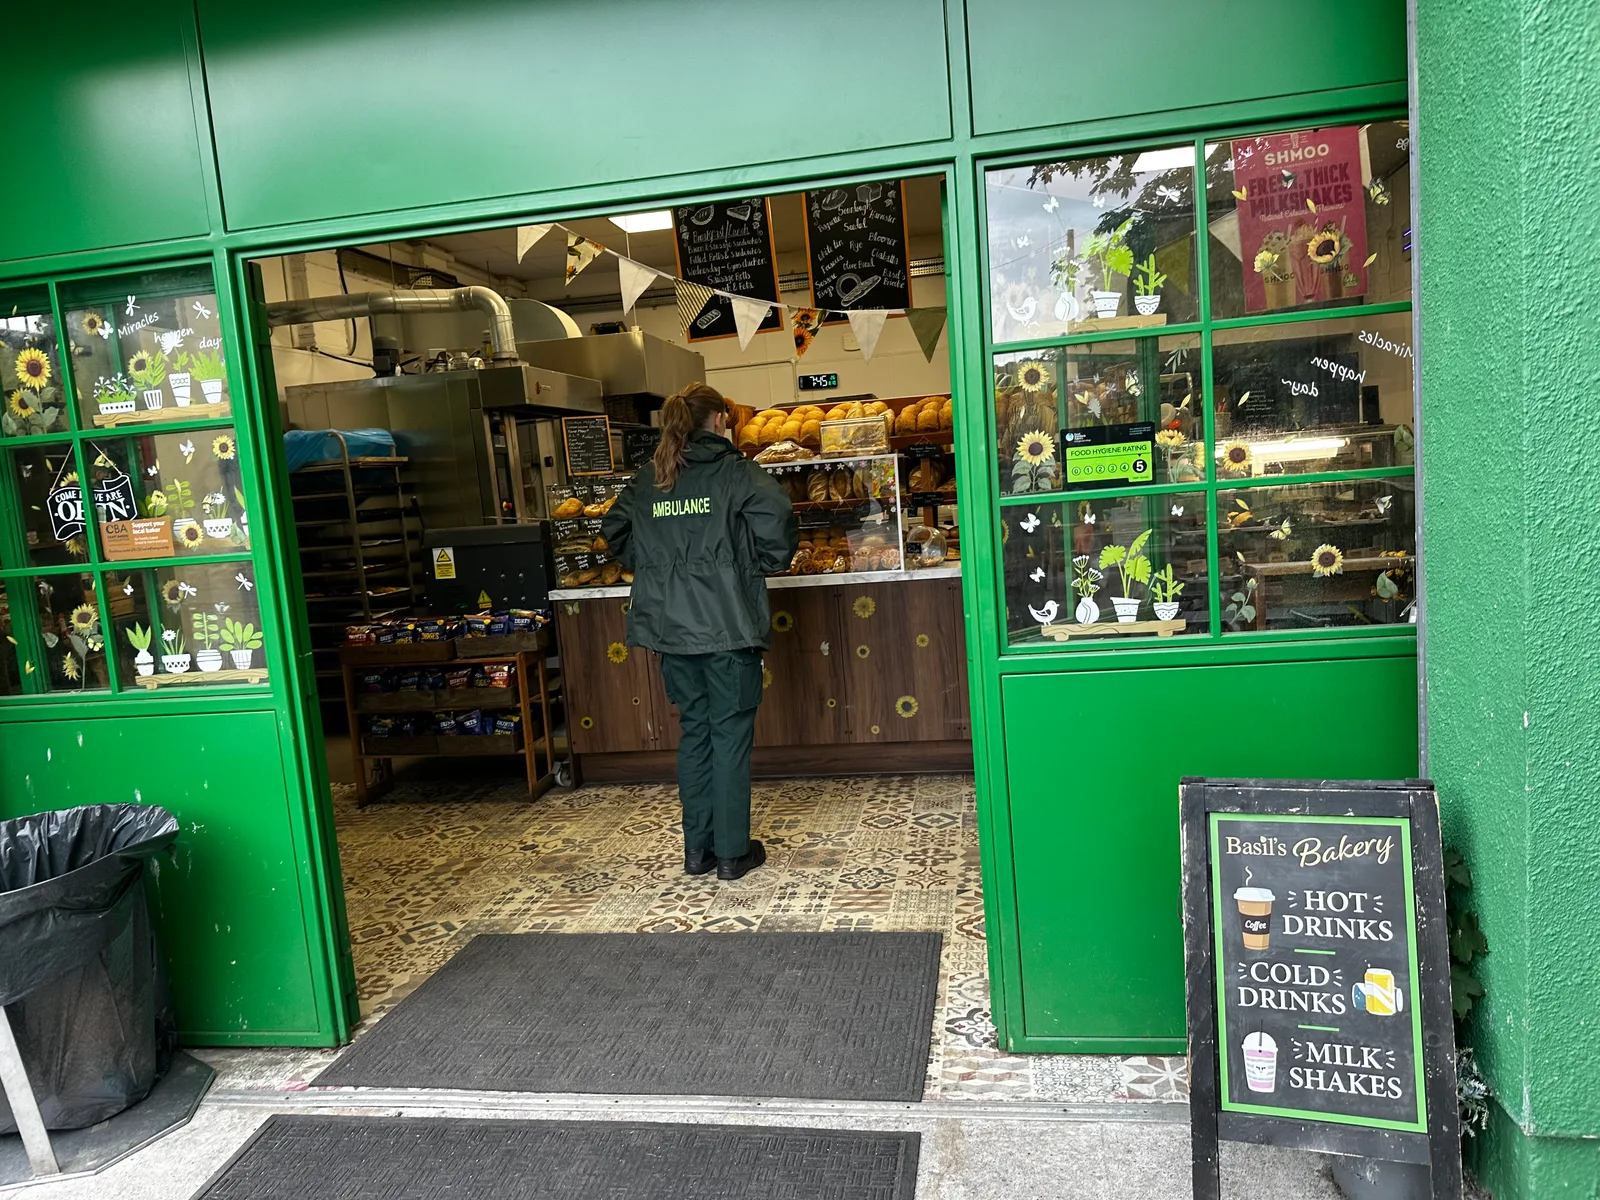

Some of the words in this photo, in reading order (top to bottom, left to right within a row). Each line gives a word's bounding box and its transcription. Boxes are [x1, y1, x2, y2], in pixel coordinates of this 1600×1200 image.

[1264, 143, 1330, 166] SHMOO
[1248, 172, 1304, 198] FRES,
[1305, 162, 1351, 188] THICK
[1250, 184, 1354, 218] MILKSHAKES
[849, 240, 863, 252] Rye
[868, 231, 898, 246] Bloomer
[118, 311, 159, 339] Miracles
[154, 328, 194, 344] hen
[1070, 449, 1092, 457] FOOD
[1093, 446, 1121, 455] HYGIENE
[1122, 444, 1147, 452] RATING
[1135, 460, 1144, 472] 5
[55, 490, 76, 502] COME
[106, 490, 123, 500] ARE
[652, 497, 711, 518] AMBULANCE
[57, 498, 128, 523] ON
[106, 524, 128, 534] CBA
[514, 618, 532, 626] BURTS
[1225, 835, 1287, 857] Basil's
[1293, 834, 1394, 867] Bakery
[1304, 889, 1368, 914] HOT
[1244, 919, 1267, 932] Coffee
[1282, 914, 1393, 942] DRINKS
[1250, 961, 1330, 987] COLD
[1237, 986, 1346, 1015] DRINKS
[1306, 1041, 1383, 1069] MILK
[1289, 1066, 1402, 1100] SHAKES
